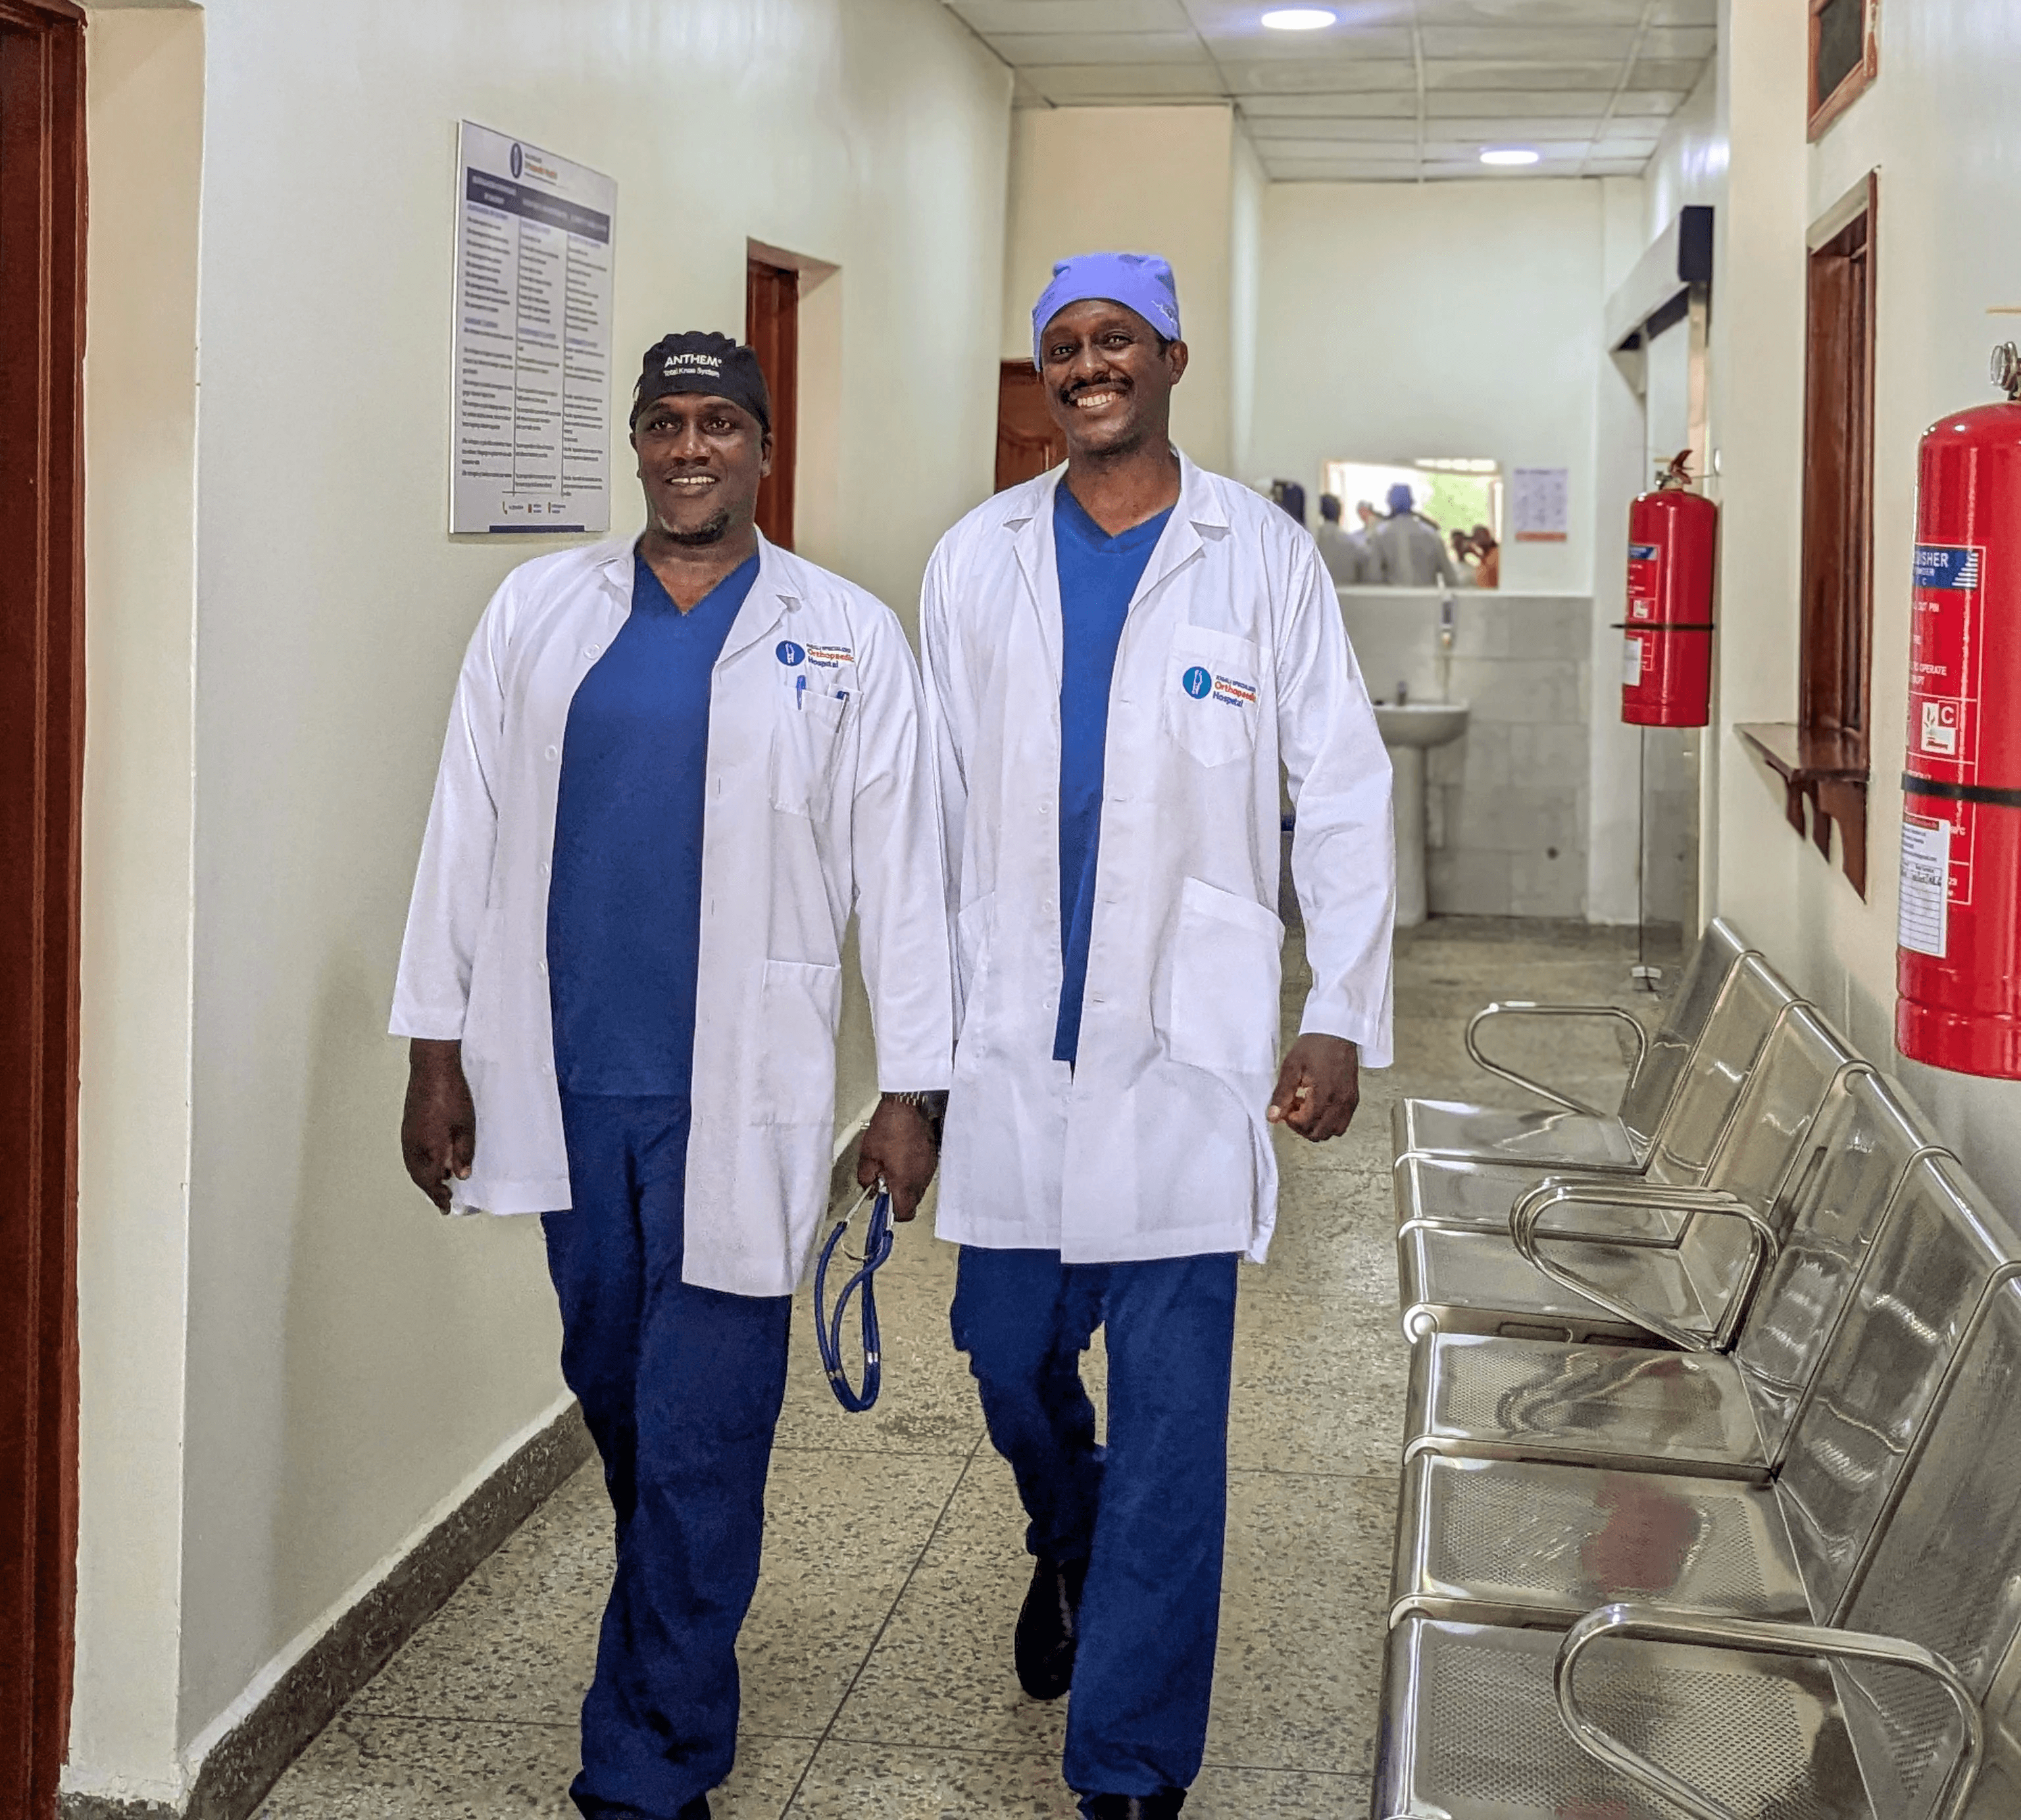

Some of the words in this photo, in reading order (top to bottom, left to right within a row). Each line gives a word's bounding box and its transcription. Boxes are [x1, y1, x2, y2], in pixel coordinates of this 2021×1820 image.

[697, 367, 720, 378] System
[807, 649, 854, 662] Orthopaedic
[808, 656, 839, 668] Hospital
[1212, 691, 1243, 707] Hospital
[1941, 706, 1955, 724] C
